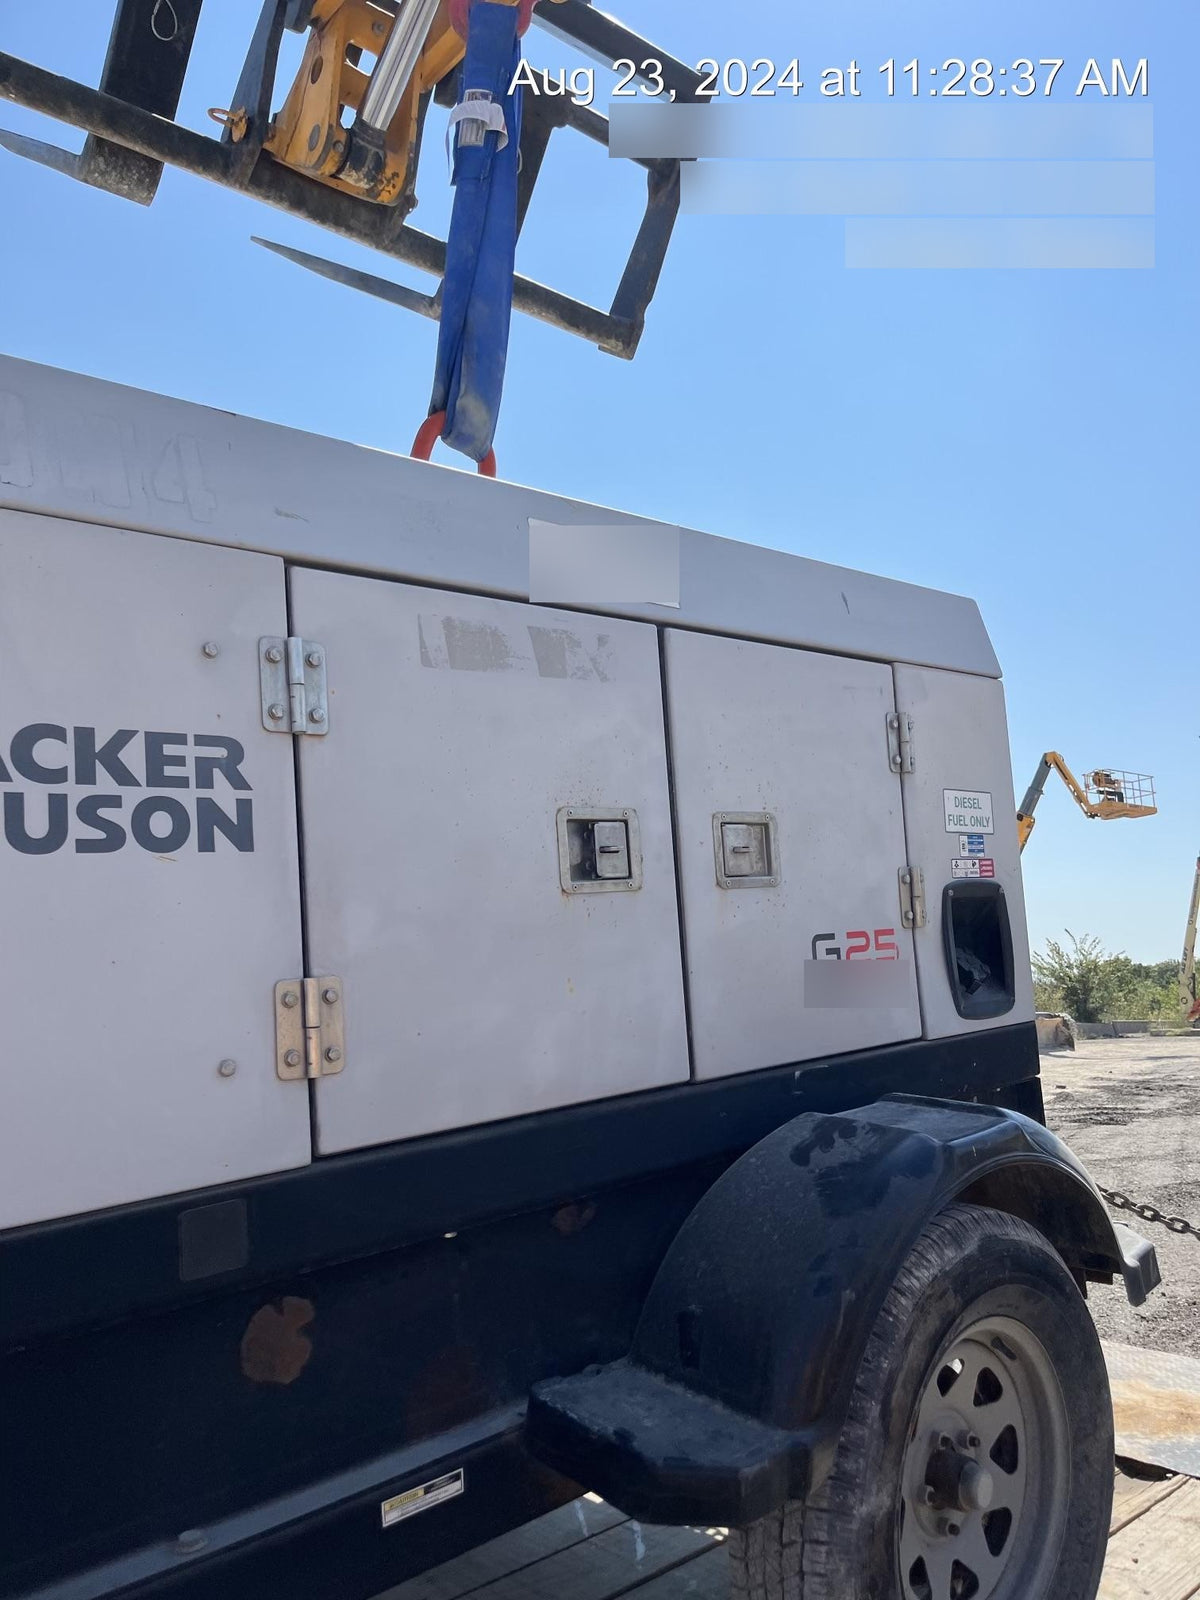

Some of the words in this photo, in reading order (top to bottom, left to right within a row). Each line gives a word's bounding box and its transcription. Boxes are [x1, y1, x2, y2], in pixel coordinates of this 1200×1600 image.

[0, 723, 253, 790] CKER
[954, 796, 982, 810] DIESEL
[948, 814, 968, 827] FUEL
[970, 815, 990, 828] ONLY
[811, 928, 900, 960] G25
